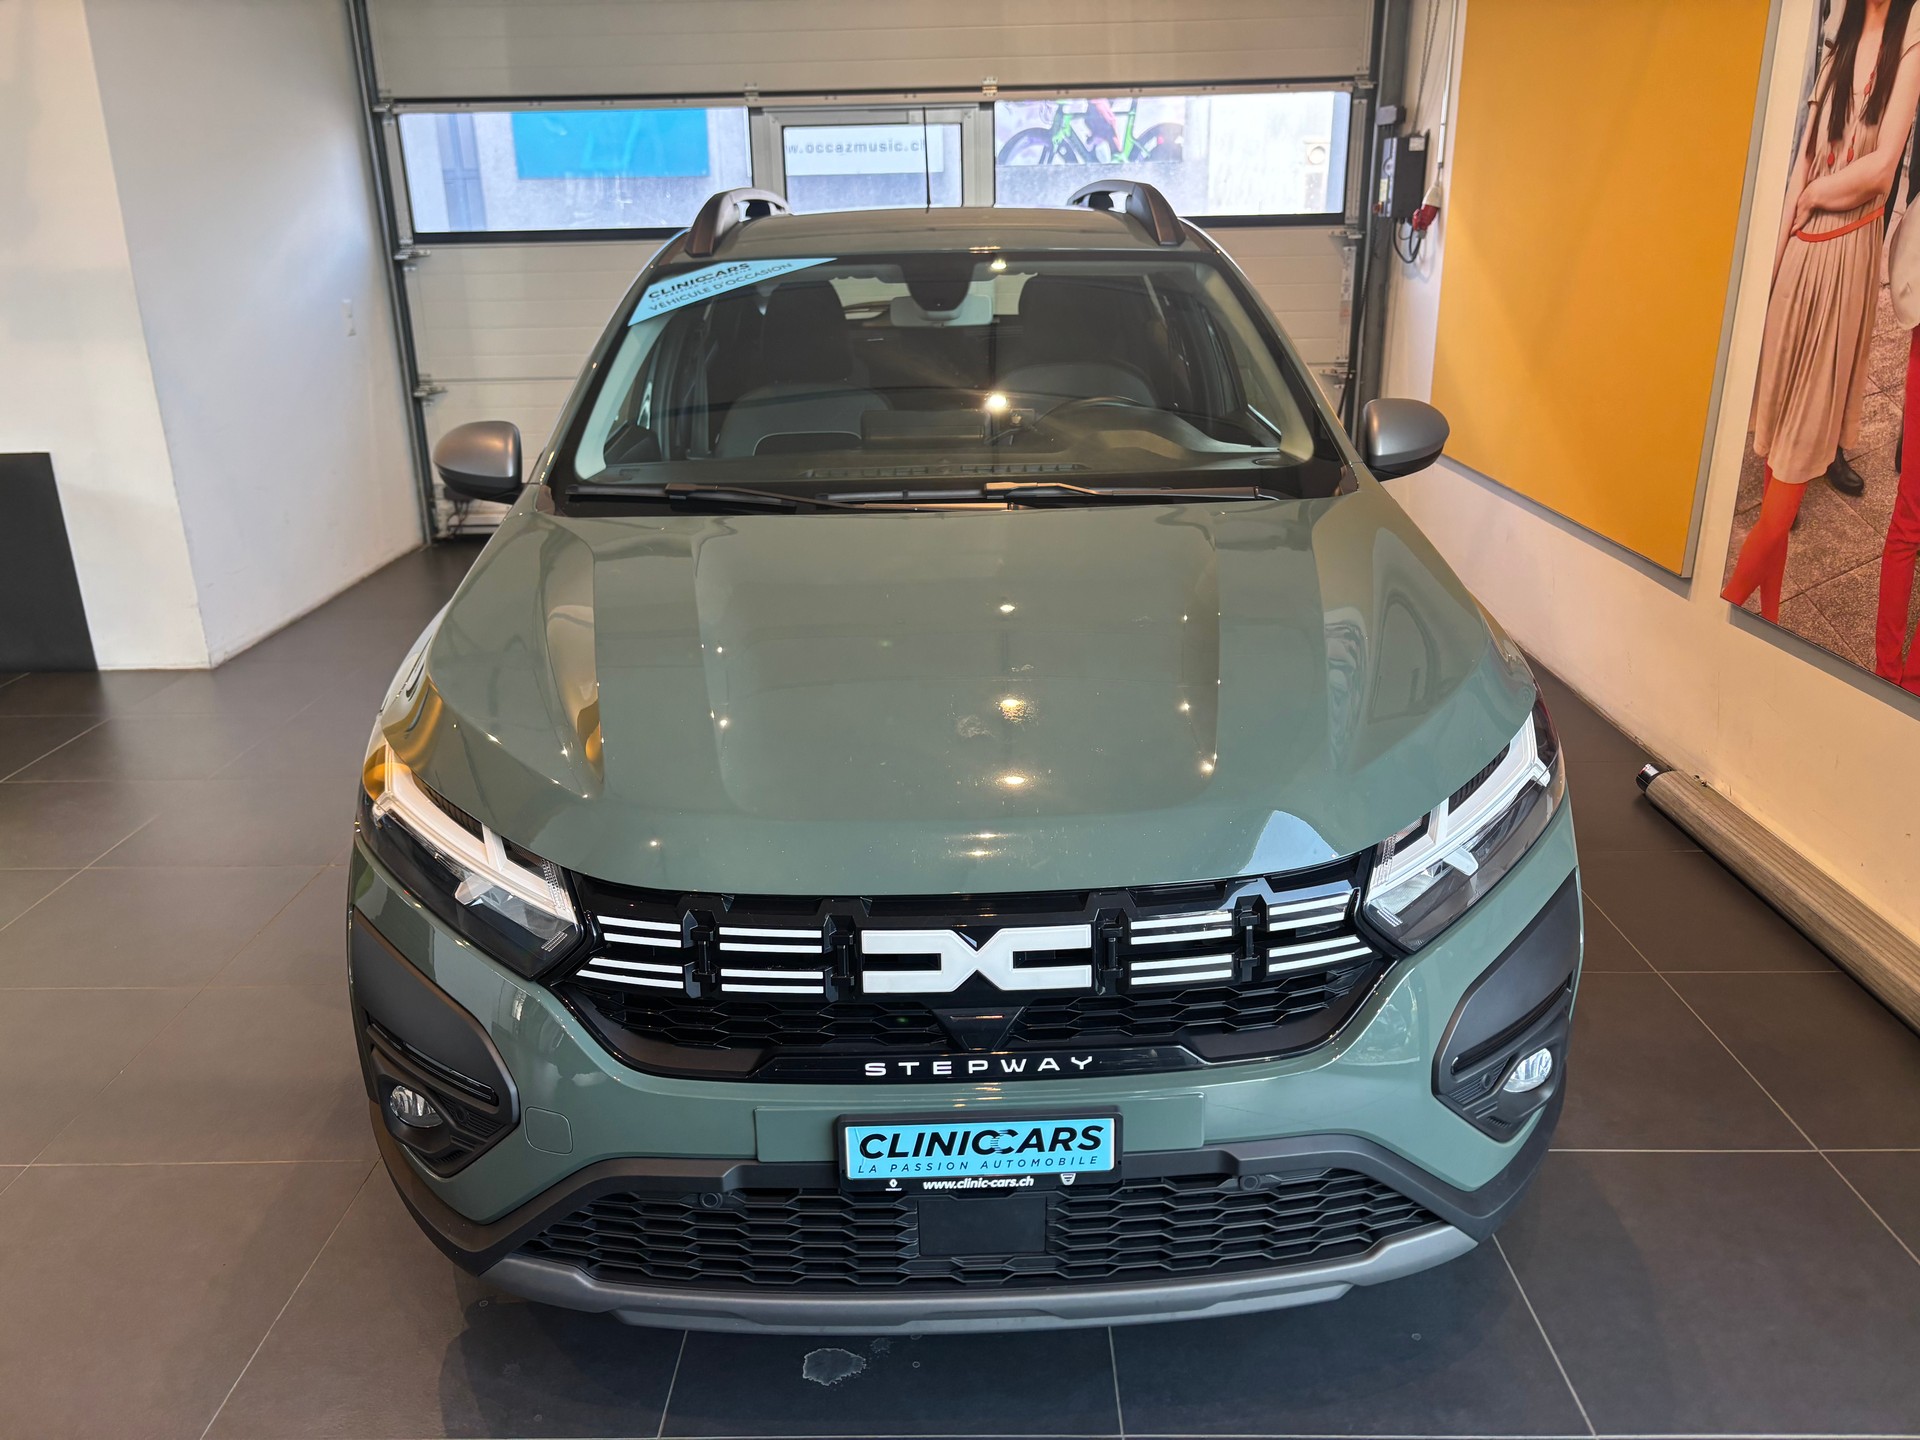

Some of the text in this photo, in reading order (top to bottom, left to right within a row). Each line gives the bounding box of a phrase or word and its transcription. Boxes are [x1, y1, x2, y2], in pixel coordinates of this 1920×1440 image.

[648, 263, 750, 299] CLINICCARS
[714, 263, 792, 290] D'OCCASION
[864, 1055, 1093, 1076] STEPWAY
[859, 1125, 1104, 1159] CLINICCARS
[858, 1155, 1098, 1173] LA PASSION AUTOMOBILE
[923, 1175, 1035, 1190] www.clinic-cars.ch
